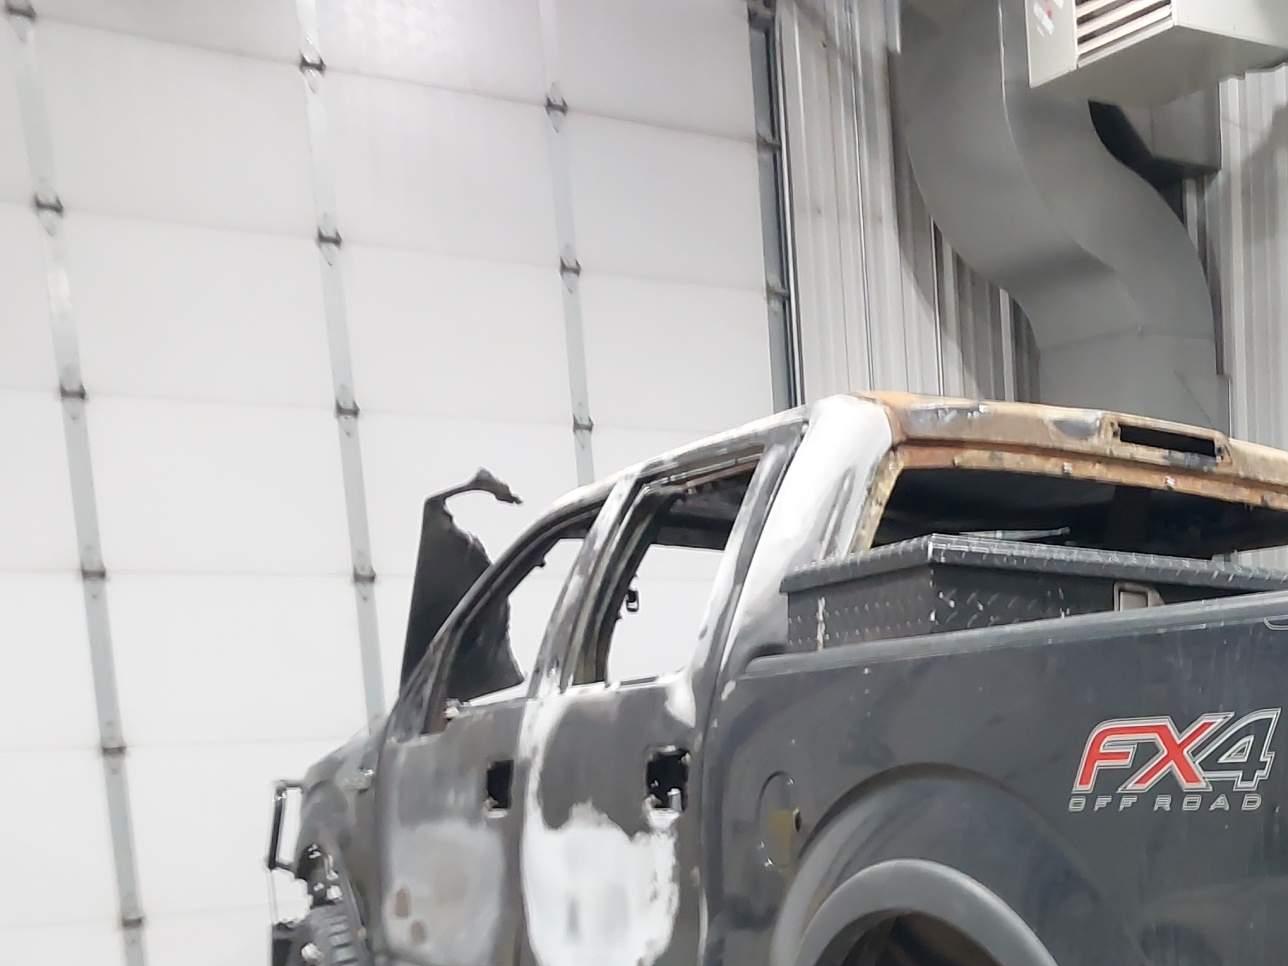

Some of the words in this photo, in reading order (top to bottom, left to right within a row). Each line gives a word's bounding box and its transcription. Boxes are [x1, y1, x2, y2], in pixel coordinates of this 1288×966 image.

[1072, 707, 1282, 793] FX4
[1068, 795, 1138, 812] OFF
[1153, 793, 1263, 812] ROAD
